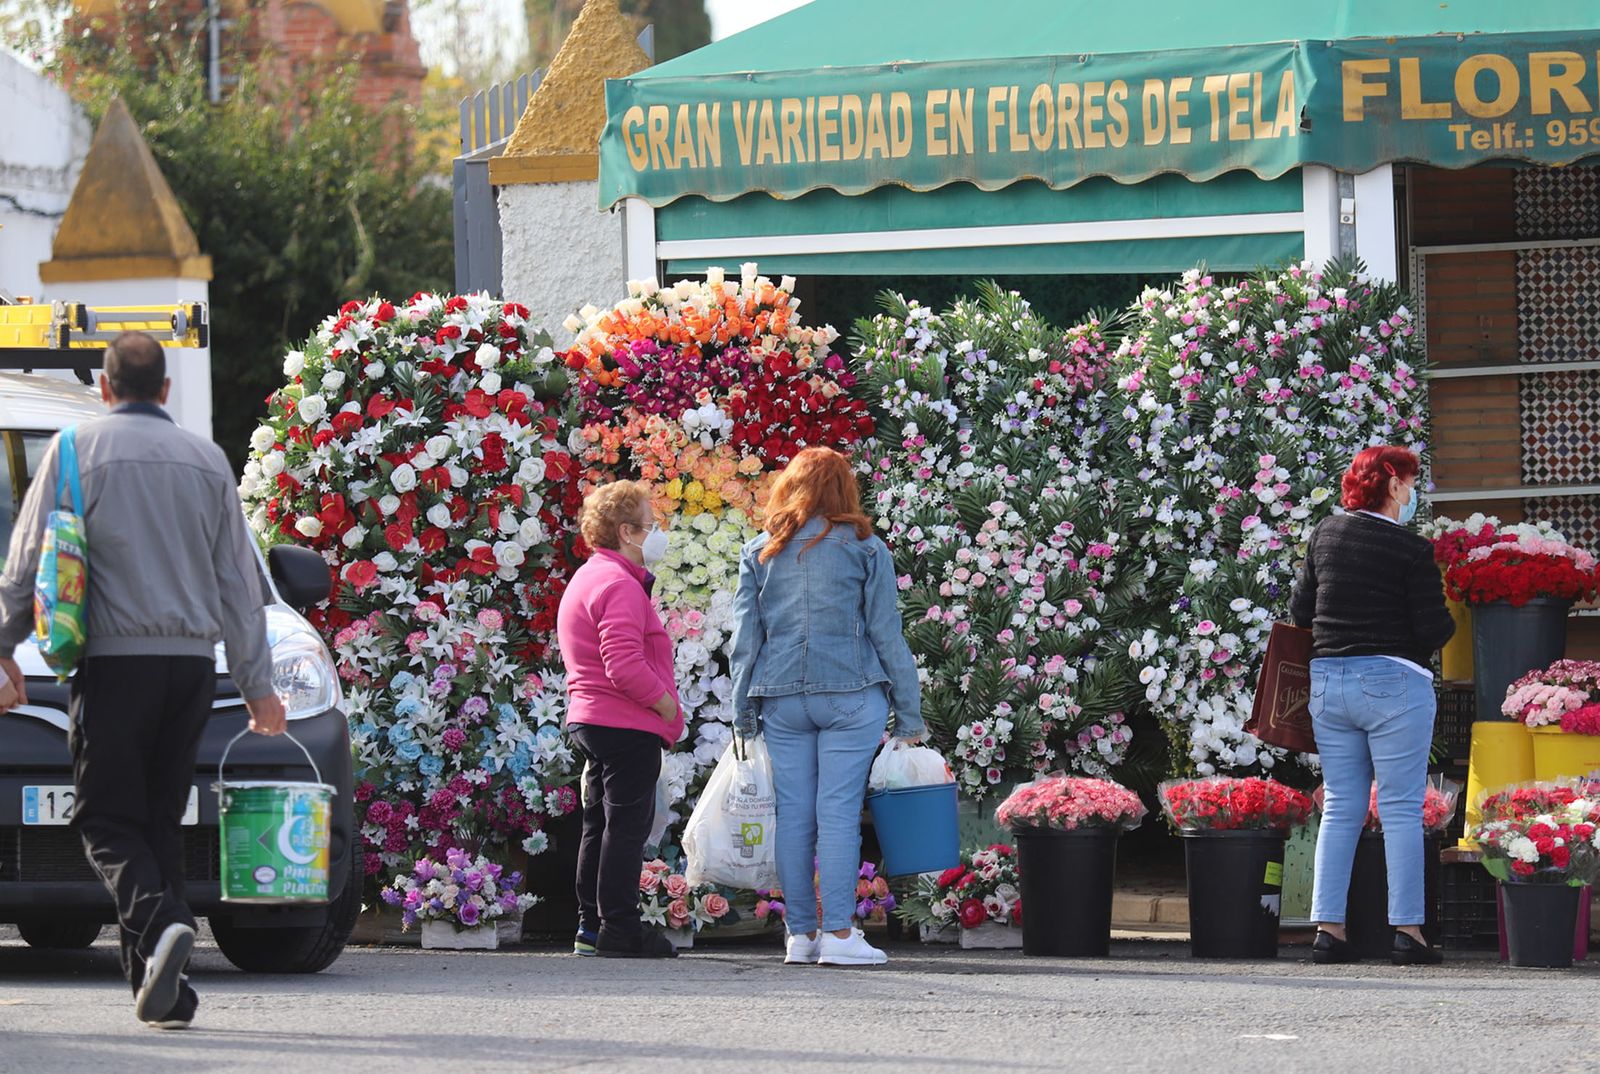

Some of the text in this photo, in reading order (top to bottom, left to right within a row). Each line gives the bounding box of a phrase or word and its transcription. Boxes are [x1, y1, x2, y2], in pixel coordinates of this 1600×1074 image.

[621, 70, 1296, 172] GRAN VARIEDAD EN FLORES DE TELA
[1341, 50, 1600, 122] FLOR
[1448, 122, 1535, 150] Telf.:
